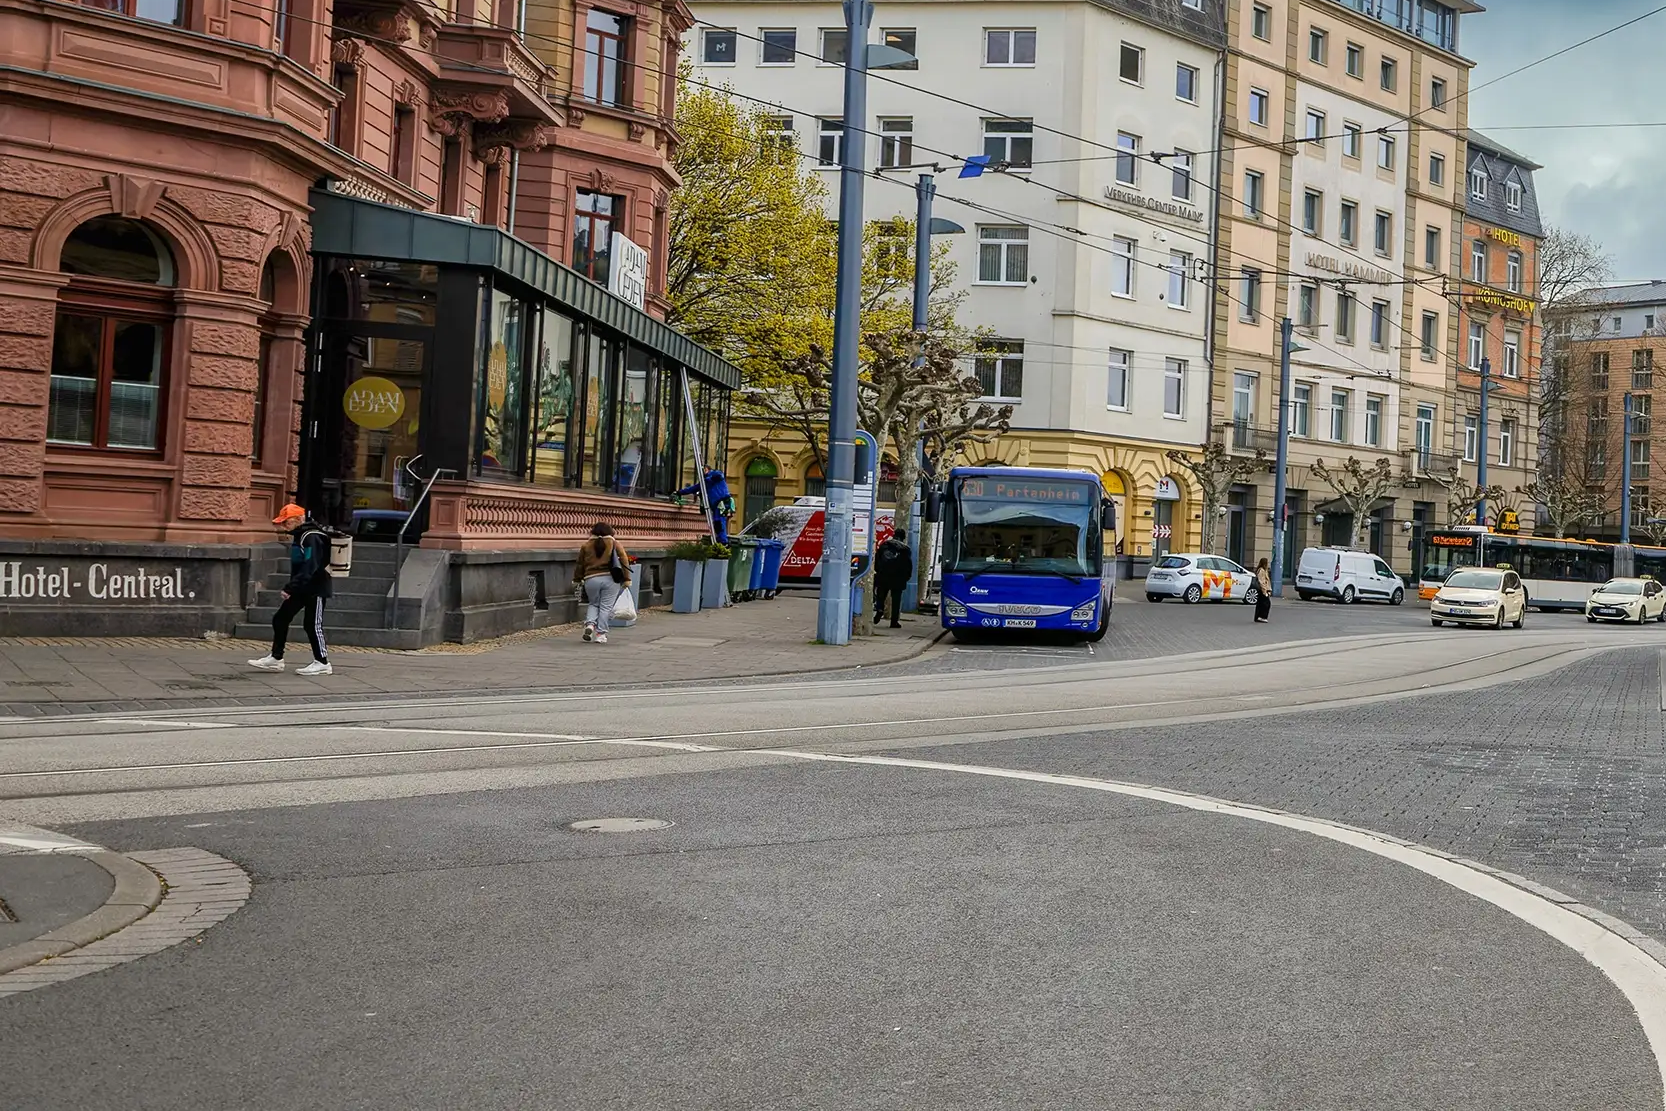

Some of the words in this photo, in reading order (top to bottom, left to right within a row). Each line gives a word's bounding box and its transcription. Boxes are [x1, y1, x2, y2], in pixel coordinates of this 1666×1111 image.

[1147, 198, 1178, 214] CENTER
[1179, 206, 1204, 222] MAINZ
[1493, 228, 1523, 246] HOTEL
[1305, 251, 1340, 273] HOTEL
[996, 484, 1080, 501] Partenheim
[790, 556, 816, 565] DELTA
[999, 605, 1042, 614] IVECO
